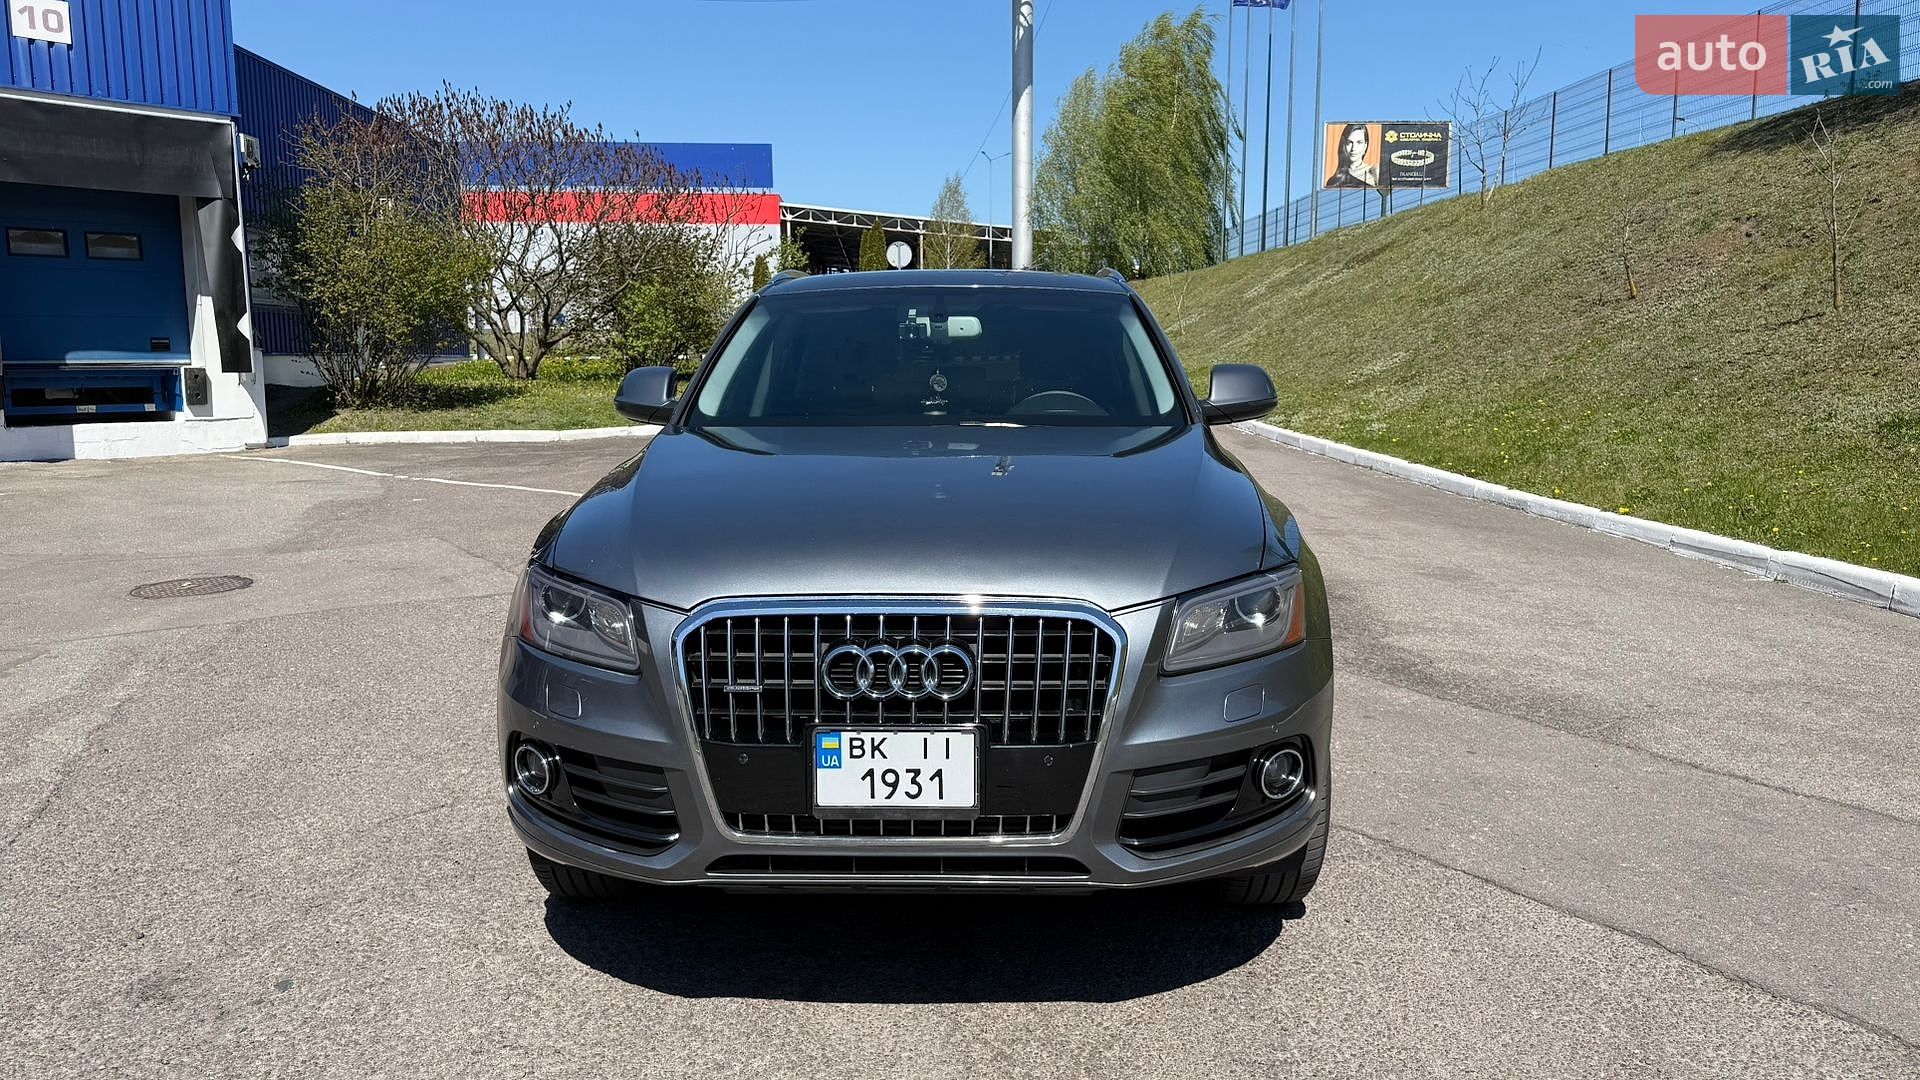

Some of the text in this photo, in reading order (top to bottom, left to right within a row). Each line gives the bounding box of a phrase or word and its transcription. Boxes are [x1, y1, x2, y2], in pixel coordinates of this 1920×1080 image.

[17, 5, 64, 34] 10
[821, 755, 840, 767] UA
[849, 737, 888, 760] BK
[860, 768, 944, 800] 1931
